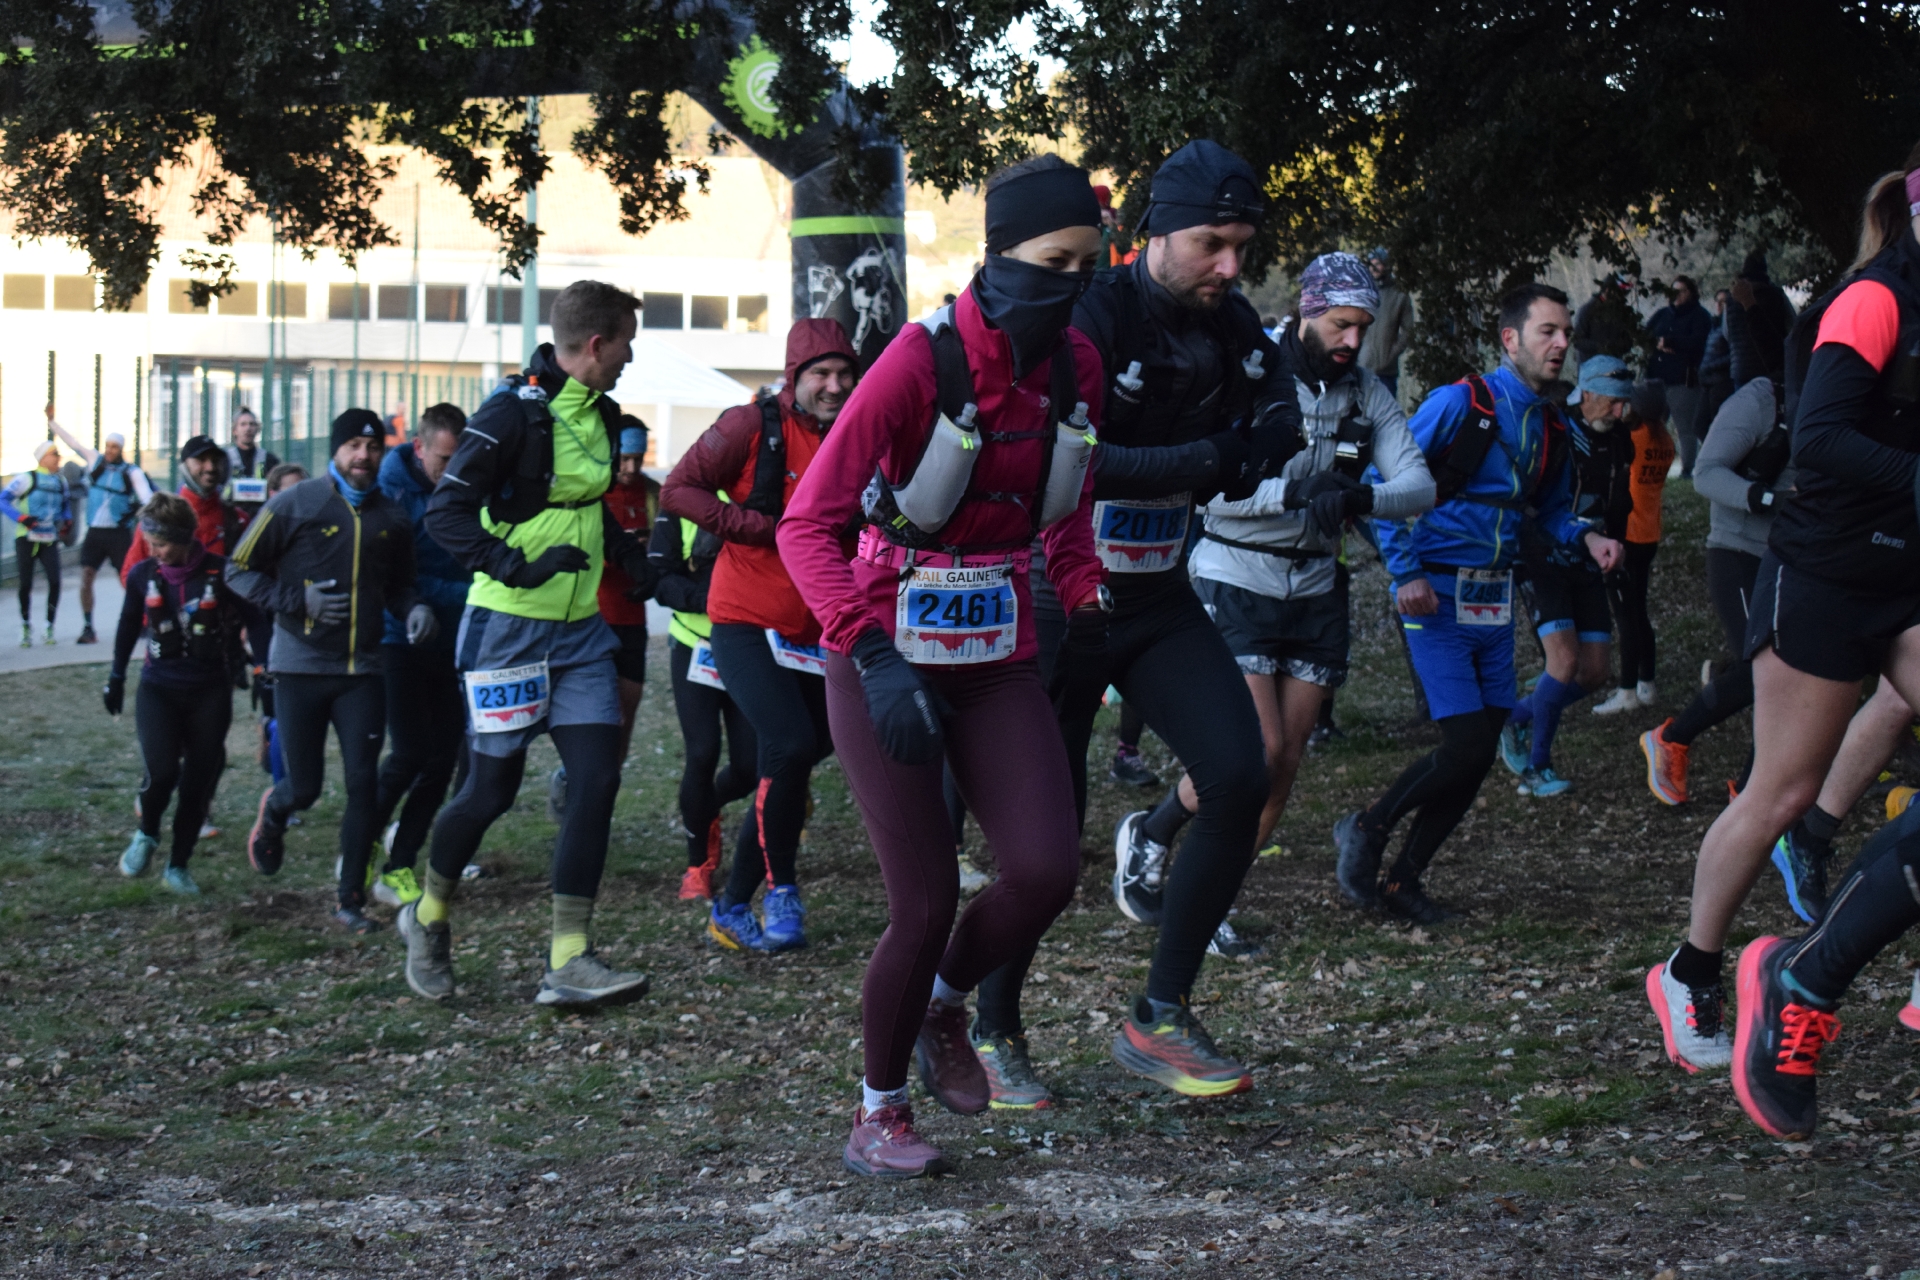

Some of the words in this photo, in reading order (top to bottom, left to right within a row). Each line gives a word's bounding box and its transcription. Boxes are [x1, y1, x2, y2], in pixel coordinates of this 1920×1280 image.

[1108, 509, 1181, 540] 2018
[912, 571, 942, 583] RAIL
[946, 567, 1003, 583] GALINETTE
[1462, 581, 1503, 603] 2498
[918, 591, 1001, 627] 2461
[478, 680, 539, 708] 2379
